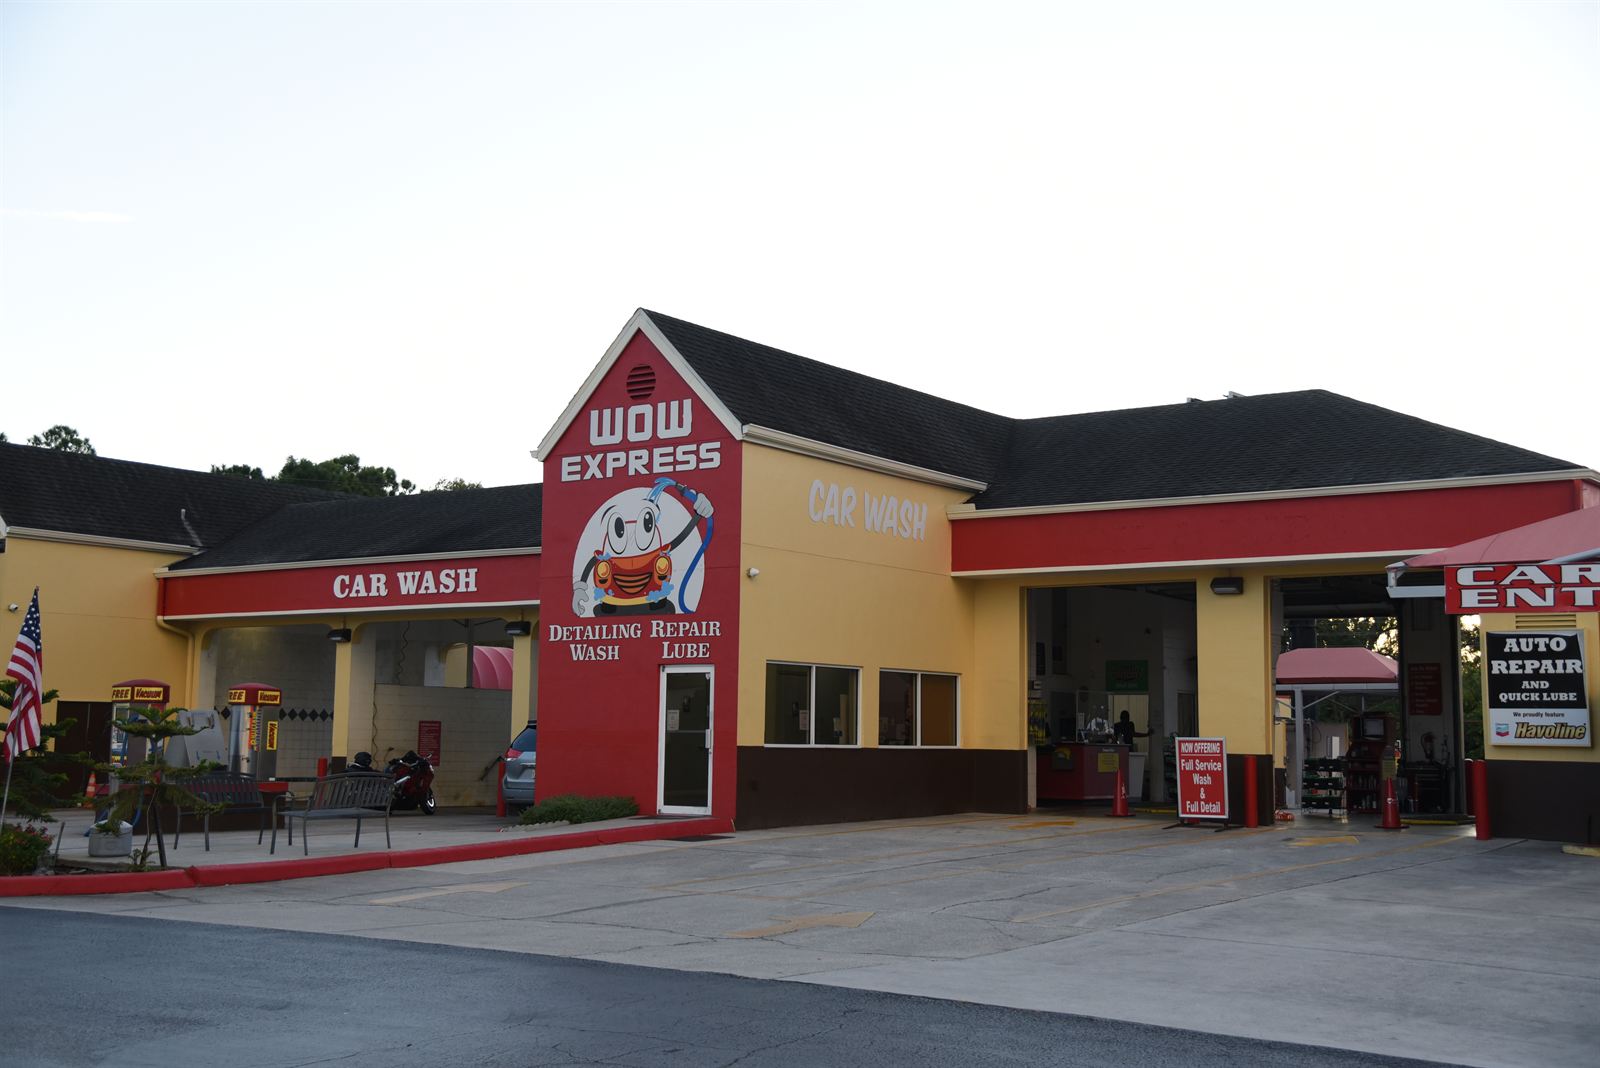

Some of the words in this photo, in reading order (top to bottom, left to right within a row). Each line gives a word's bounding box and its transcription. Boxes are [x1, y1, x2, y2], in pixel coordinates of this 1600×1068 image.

[589, 398, 693, 446] WOW
[561, 441, 722, 482] EXPRESS
[808, 479, 857, 528] CAR
[863, 489, 928, 542] WASH
[332, 573, 388, 599] CAR
[396, 567, 479, 595] WASH
[1456, 564, 1600, 586] CAR
[548, 623, 642, 643] DETAILING
[650, 620, 722, 639] REPAIR
[569, 644, 620, 661] WASH
[662, 642, 710, 659] LUBE
[1503, 637, 1567, 653] AUTO
[1491, 659, 1584, 675] REPAIR
[1521, 680, 1550, 689] AND
[112, 688, 130, 699] FREE
[228, 691, 244, 701] REE
[1498, 692, 1540, 703] QUICK
[1542, 692, 1577, 702] LUBE
[1522, 711, 1543, 719] proudly
[1514, 721, 1586, 739] Havoline
[1181, 743, 1193, 753] NOW
[1194, 742, 1220, 753] OFFERING
[1181, 759, 1194, 770] Full
[1195, 759, 1222, 771] Service
[1192, 773, 1212, 785] Wash
[1200, 787, 1206, 799] &
[1186, 801, 1199, 812] Full
[1200, 801, 1221, 813] Detail
